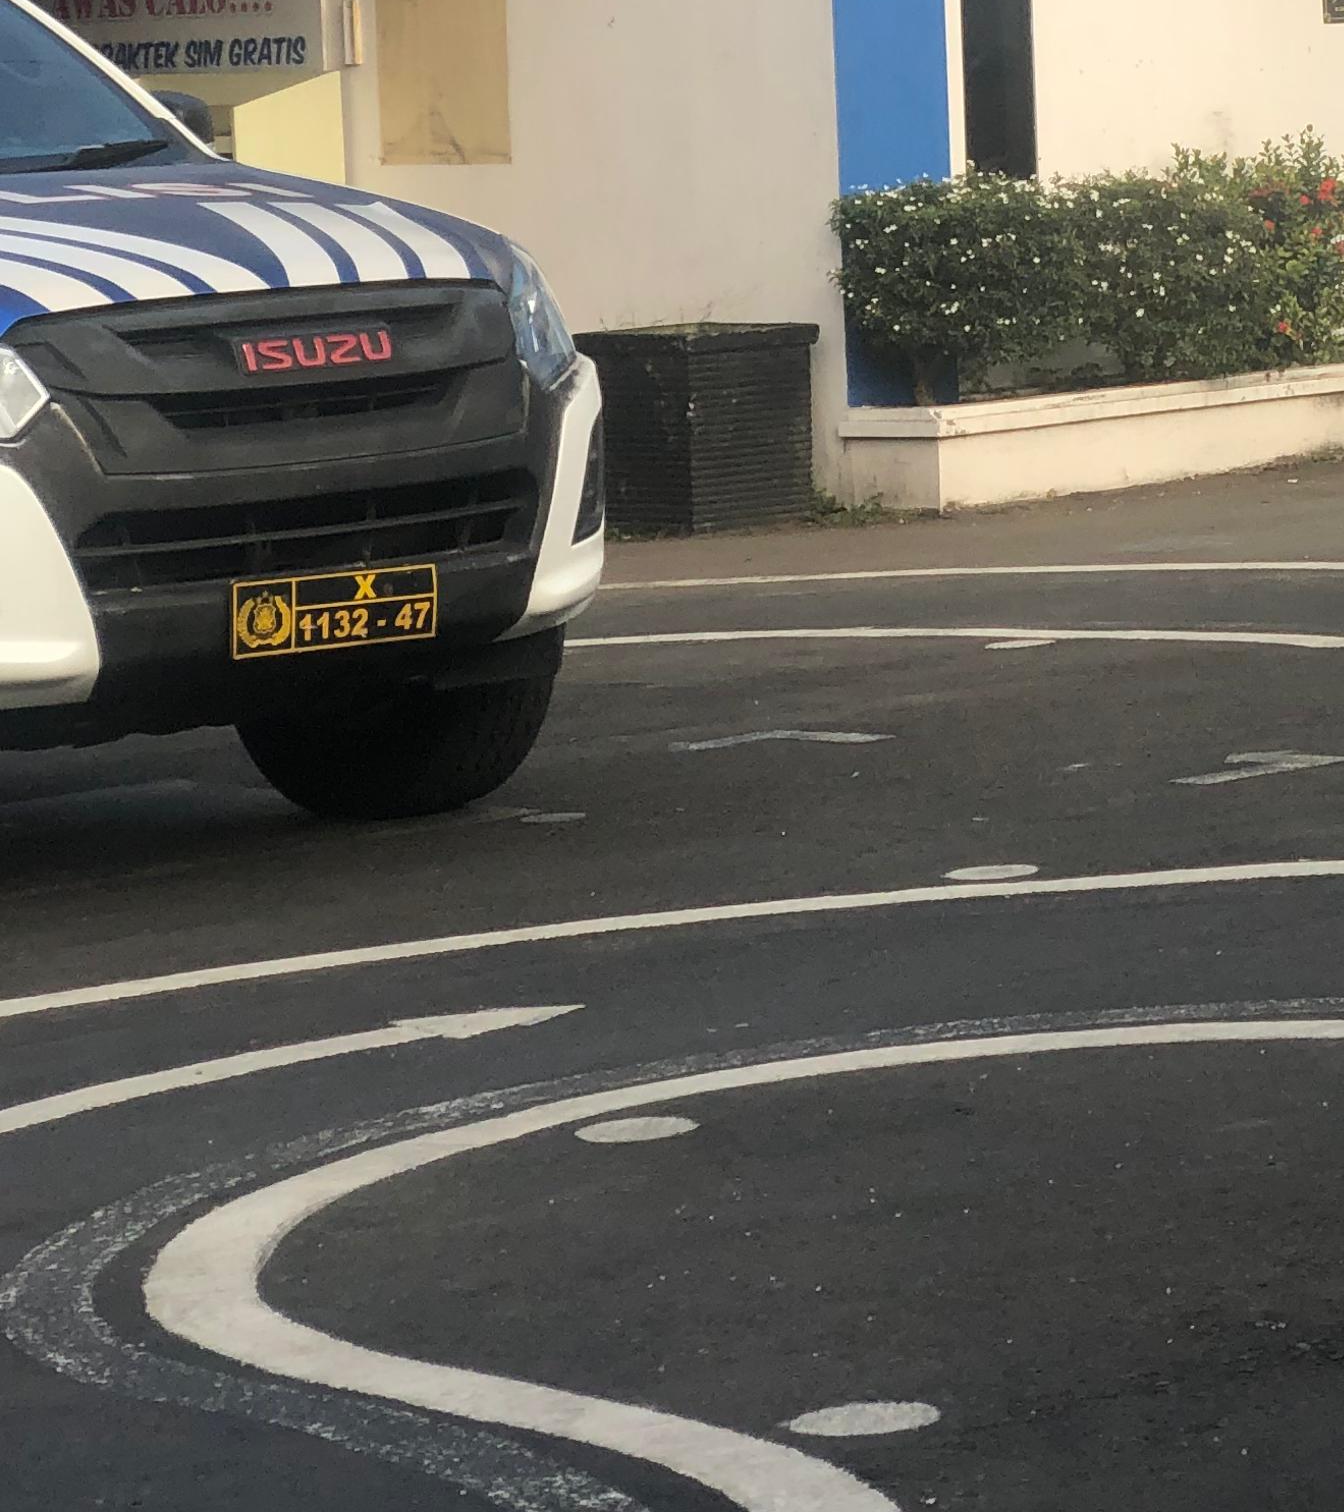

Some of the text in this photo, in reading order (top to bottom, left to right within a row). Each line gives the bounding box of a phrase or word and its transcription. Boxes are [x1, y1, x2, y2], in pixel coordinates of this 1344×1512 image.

[185, 39, 224, 69] SIM
[229, 36, 306, 66] GRATIS
[242, 329, 392, 373] ISUZU
[354, 574, 376, 600] X
